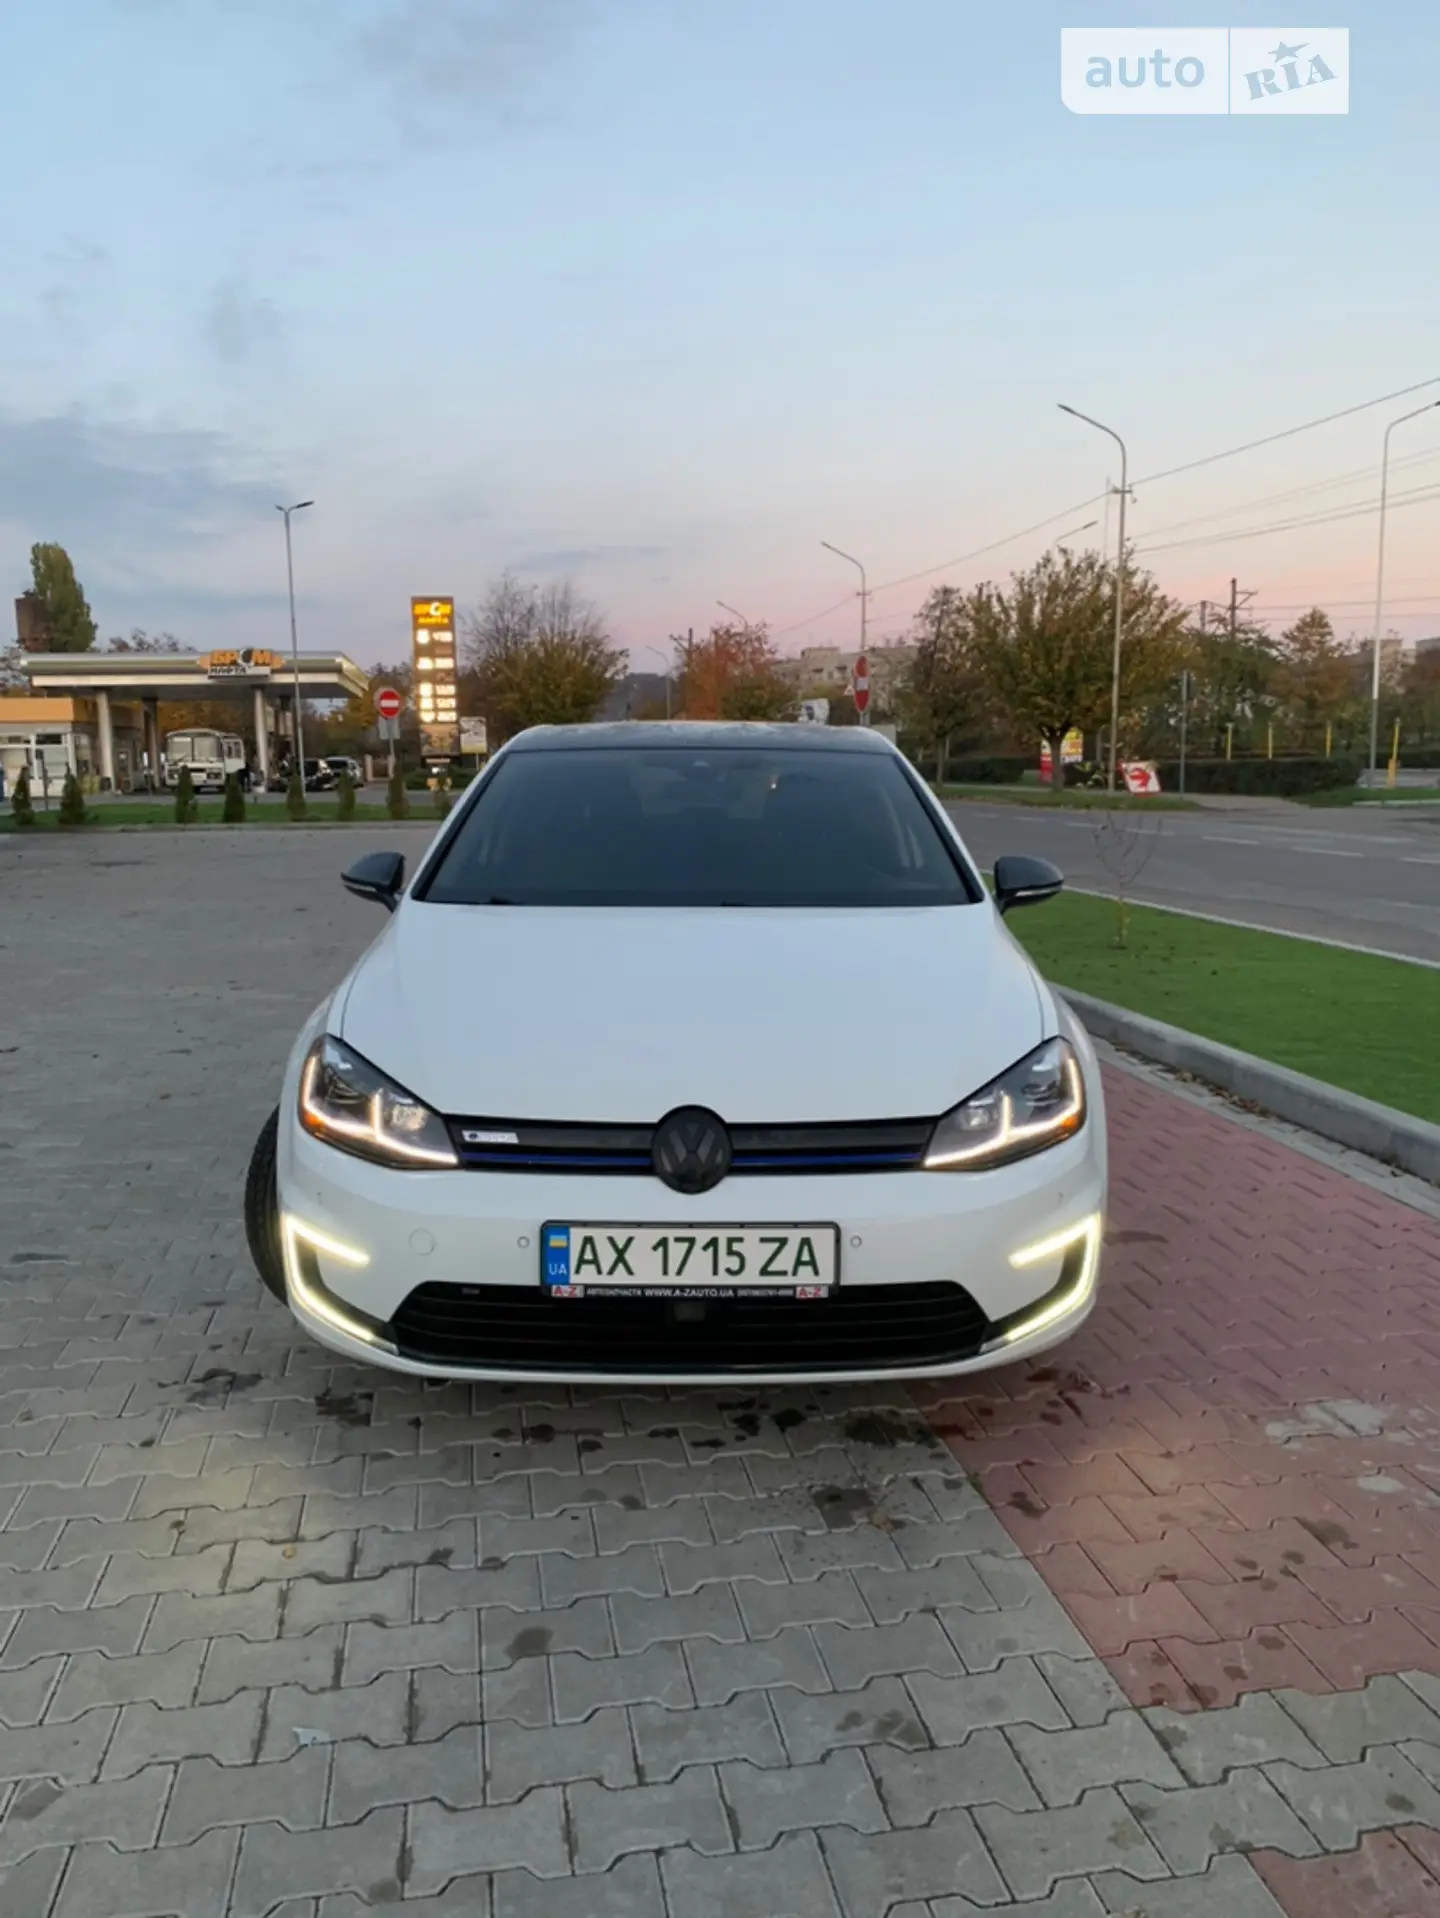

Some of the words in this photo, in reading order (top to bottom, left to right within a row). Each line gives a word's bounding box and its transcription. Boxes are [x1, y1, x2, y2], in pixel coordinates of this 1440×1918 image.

[549, 1263, 567, 1275] UA
[574, 1235, 635, 1276] AX
[652, 1236, 746, 1277] 1715
[758, 1236, 820, 1277] ZA
